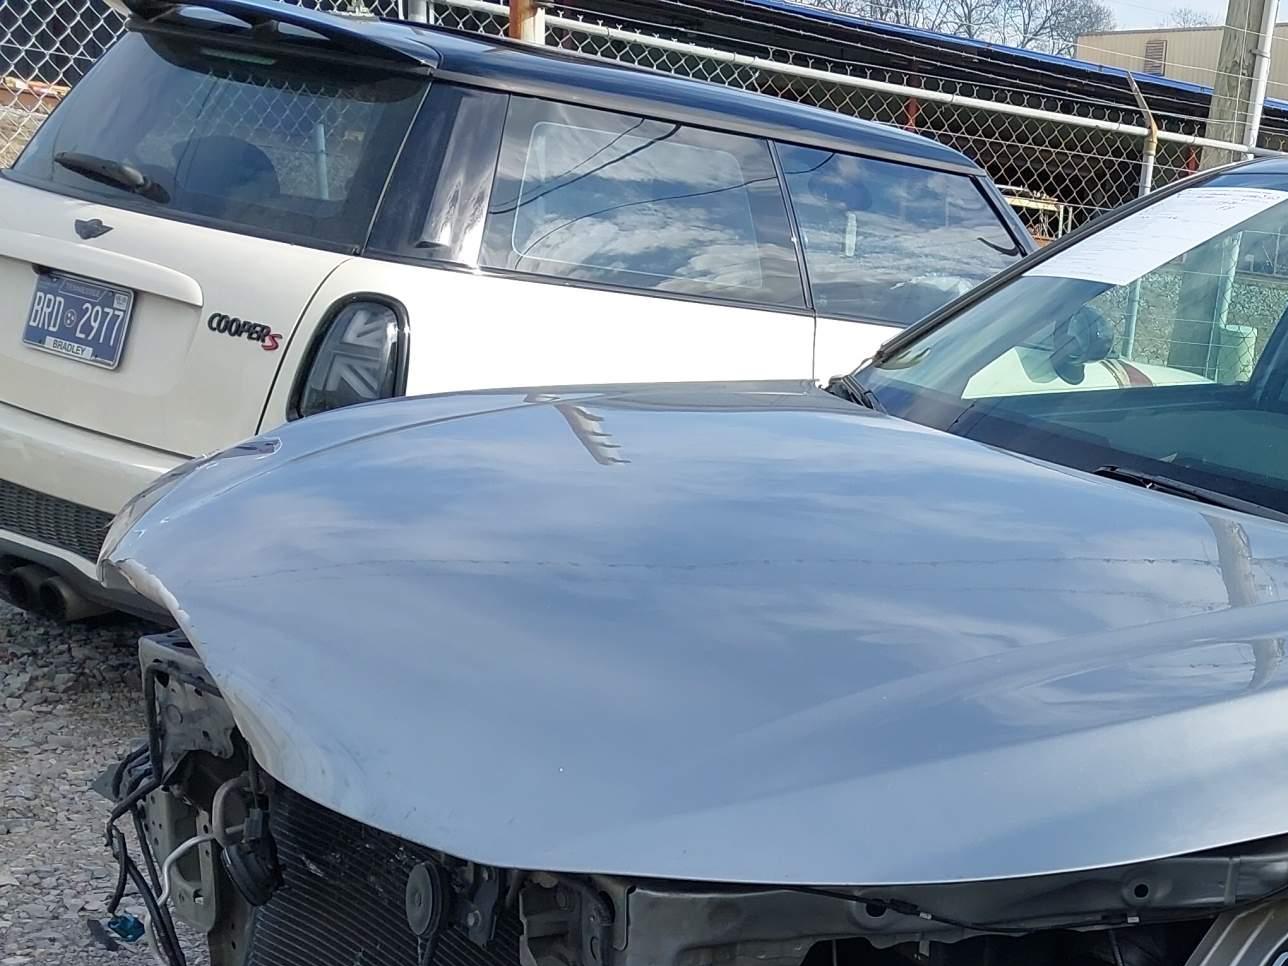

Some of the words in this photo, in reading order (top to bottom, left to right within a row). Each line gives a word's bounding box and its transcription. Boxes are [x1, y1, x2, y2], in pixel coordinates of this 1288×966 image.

[29, 291, 63, 333] BRD
[75, 302, 125, 347] 2977
[207, 312, 272, 344] COOPER
[261, 333, 283, 351] S
[51, 338, 87, 357] BRADLEY
